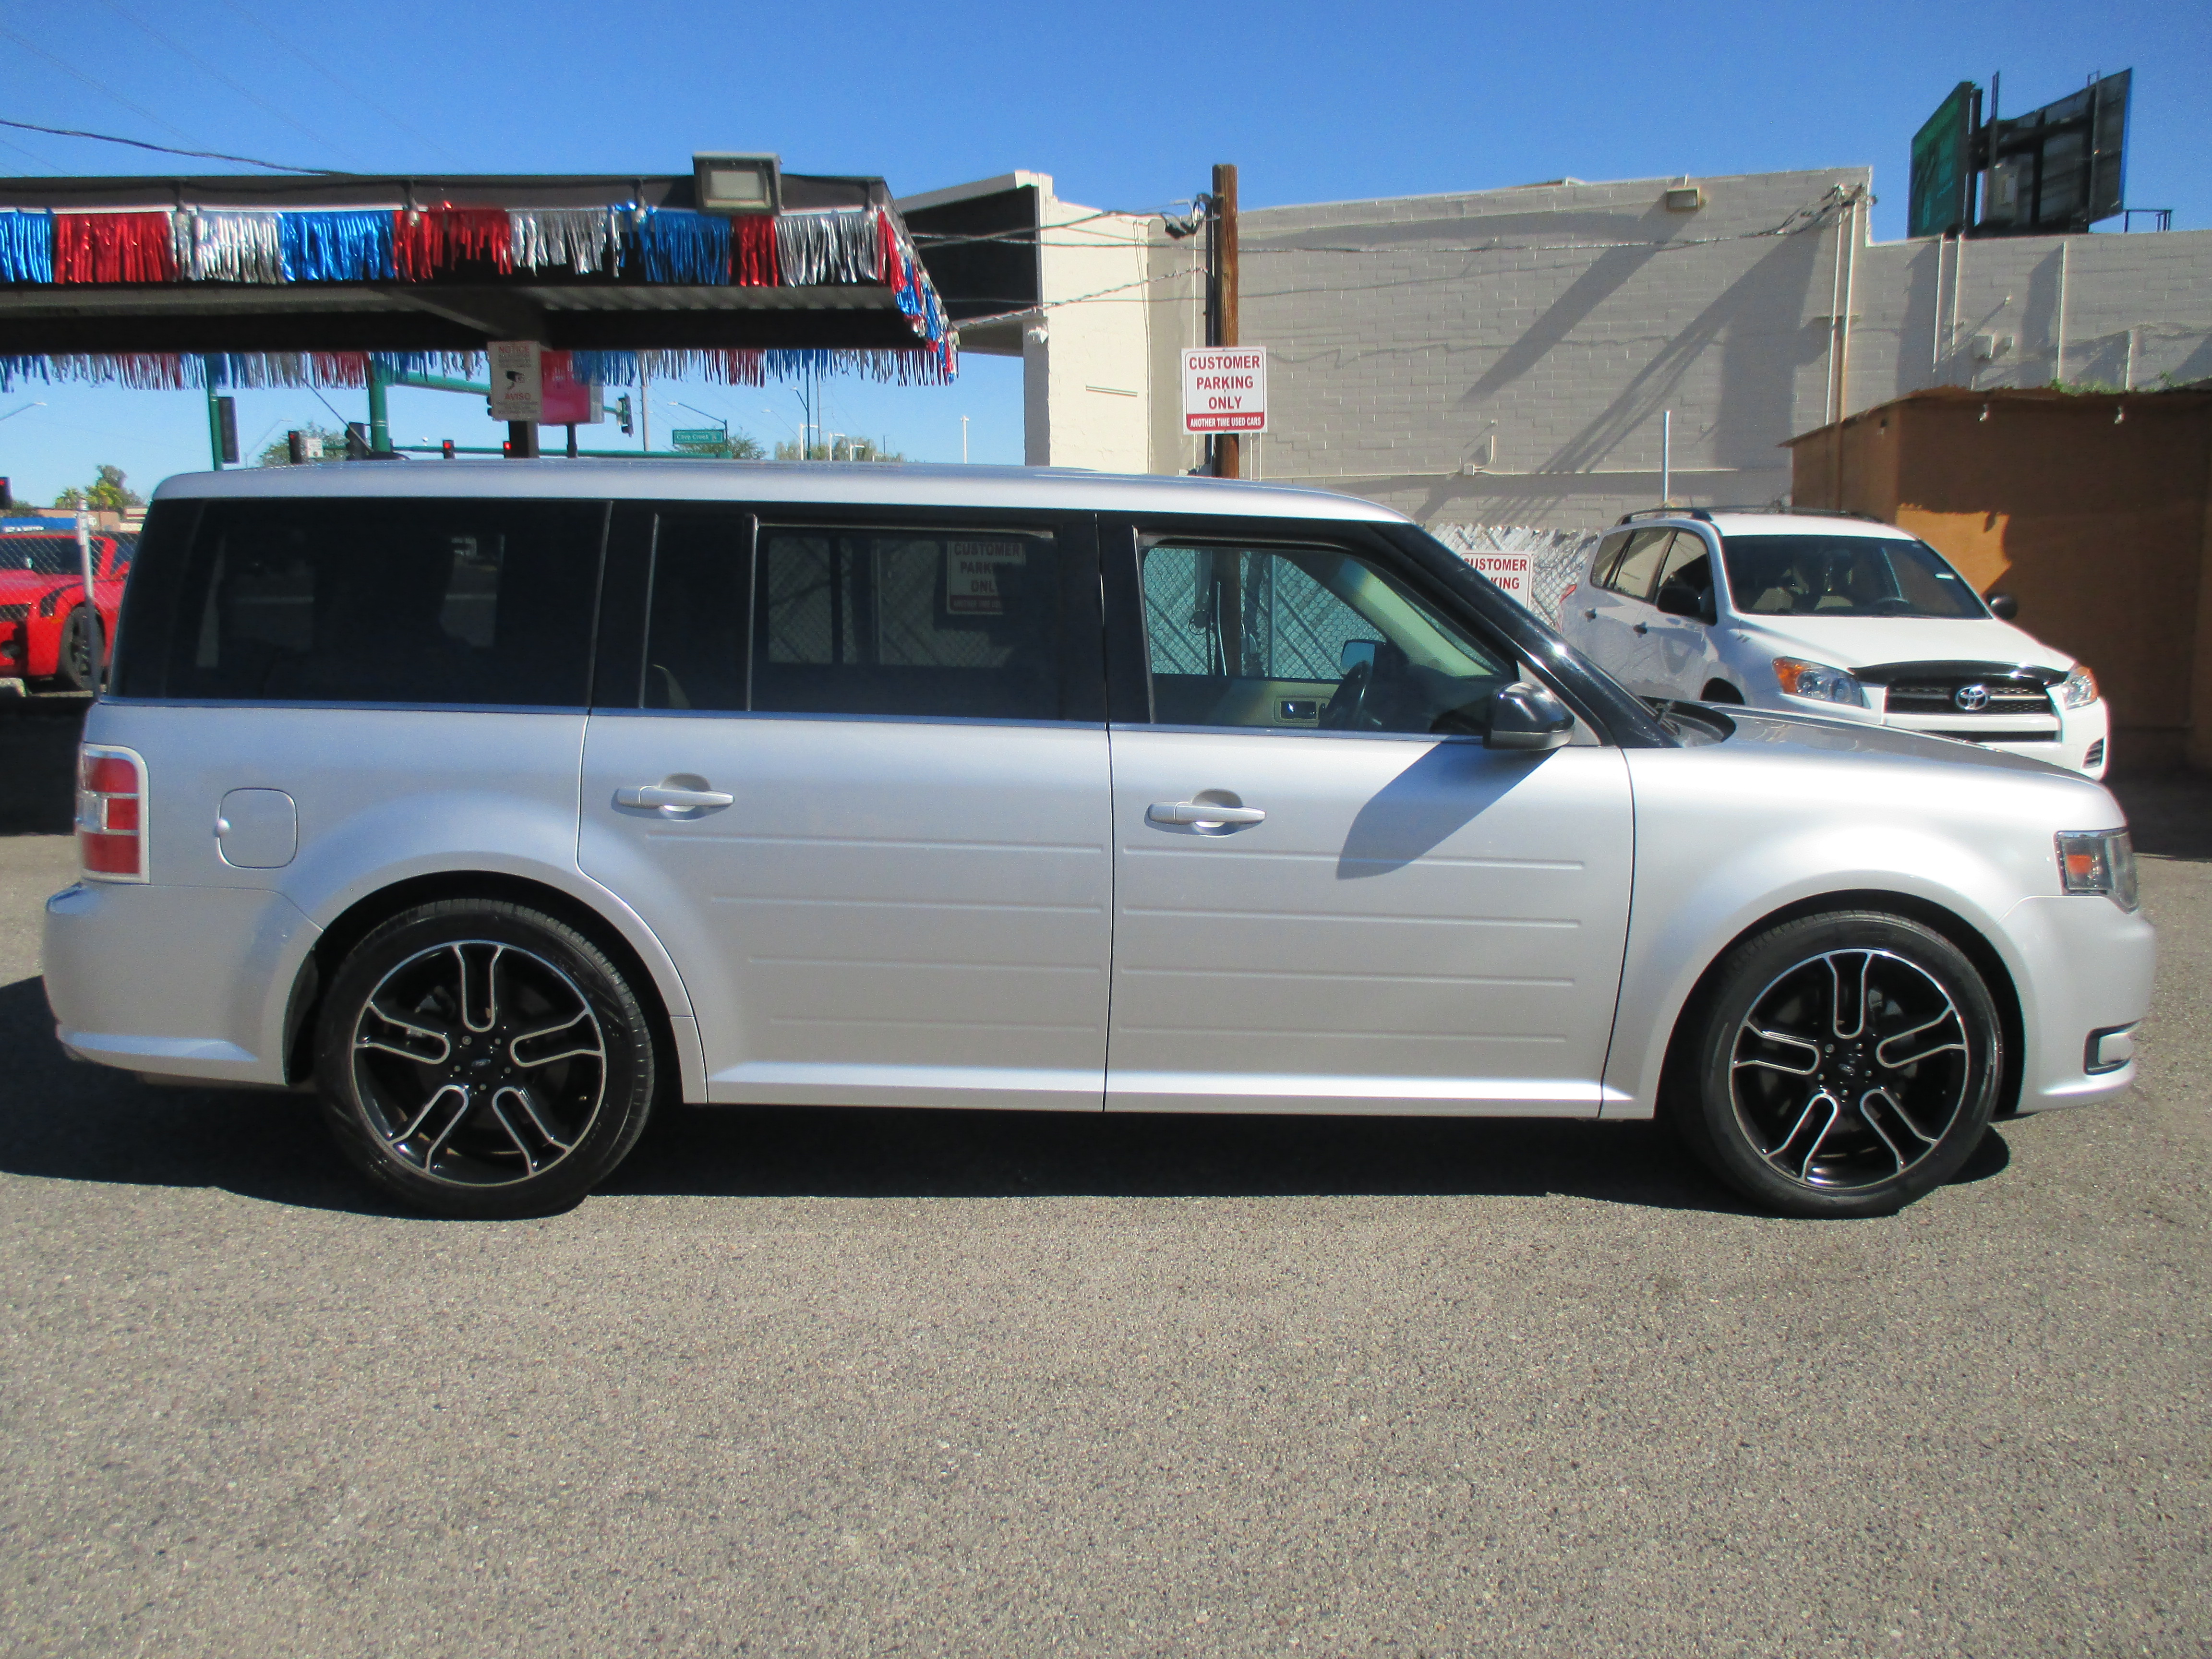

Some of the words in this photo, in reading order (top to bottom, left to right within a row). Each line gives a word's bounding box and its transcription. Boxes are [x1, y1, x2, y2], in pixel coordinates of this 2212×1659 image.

[1189, 356, 1260, 370] CUSTOMER
[1196, 375, 1254, 390] PARKING
[1208, 396, 1242, 410] ONLY
[1190, 417, 1216, 428] ANOTHER
[1217, 417, 1230, 427] TIME
[1231, 417, 1246, 426] USED
[1247, 416, 1261, 426] CARS
[971, 579, 995, 592] ONL
